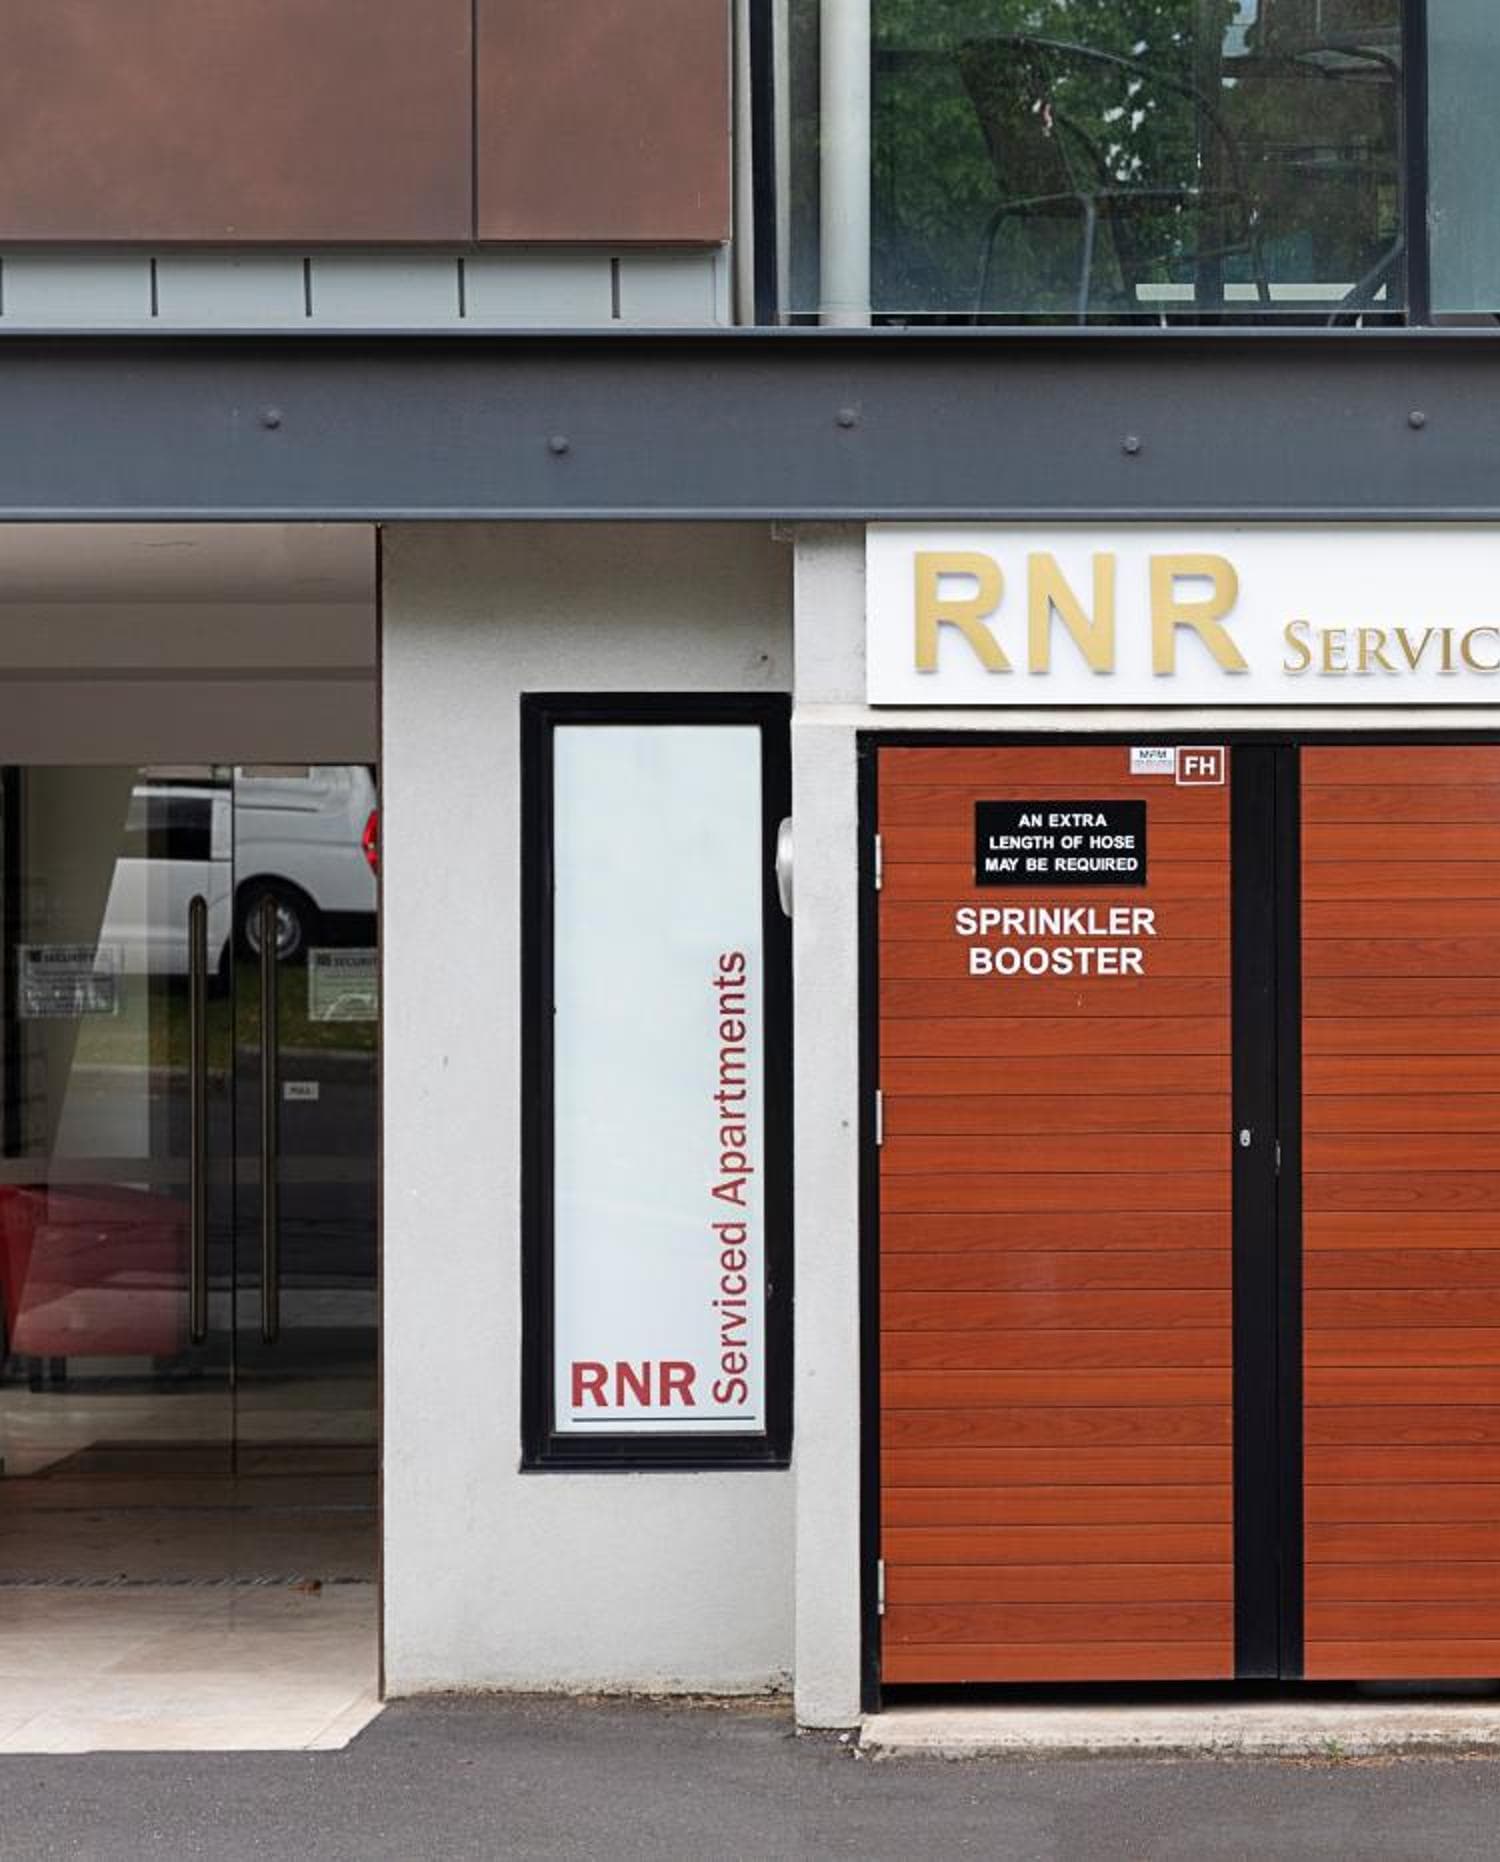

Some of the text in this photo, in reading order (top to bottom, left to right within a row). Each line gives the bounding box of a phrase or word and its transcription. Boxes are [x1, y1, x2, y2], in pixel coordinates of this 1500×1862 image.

[912, 552, 1249, 674] RNR
[1184, 755, 1216, 776] FH
[1018, 813, 1108, 828] AN EXTRA
[989, 835, 1135, 850] LENGTH OF HOSE
[985, 857, 1139, 873] MAY BE REQUIRED
[955, 907, 1157, 936] SPRINKLER
[968, 946, 1146, 976] BOOSTER
[711, 950, 754, 1406] Serviced Apartments
[571, 1361, 697, 1408] RNR
